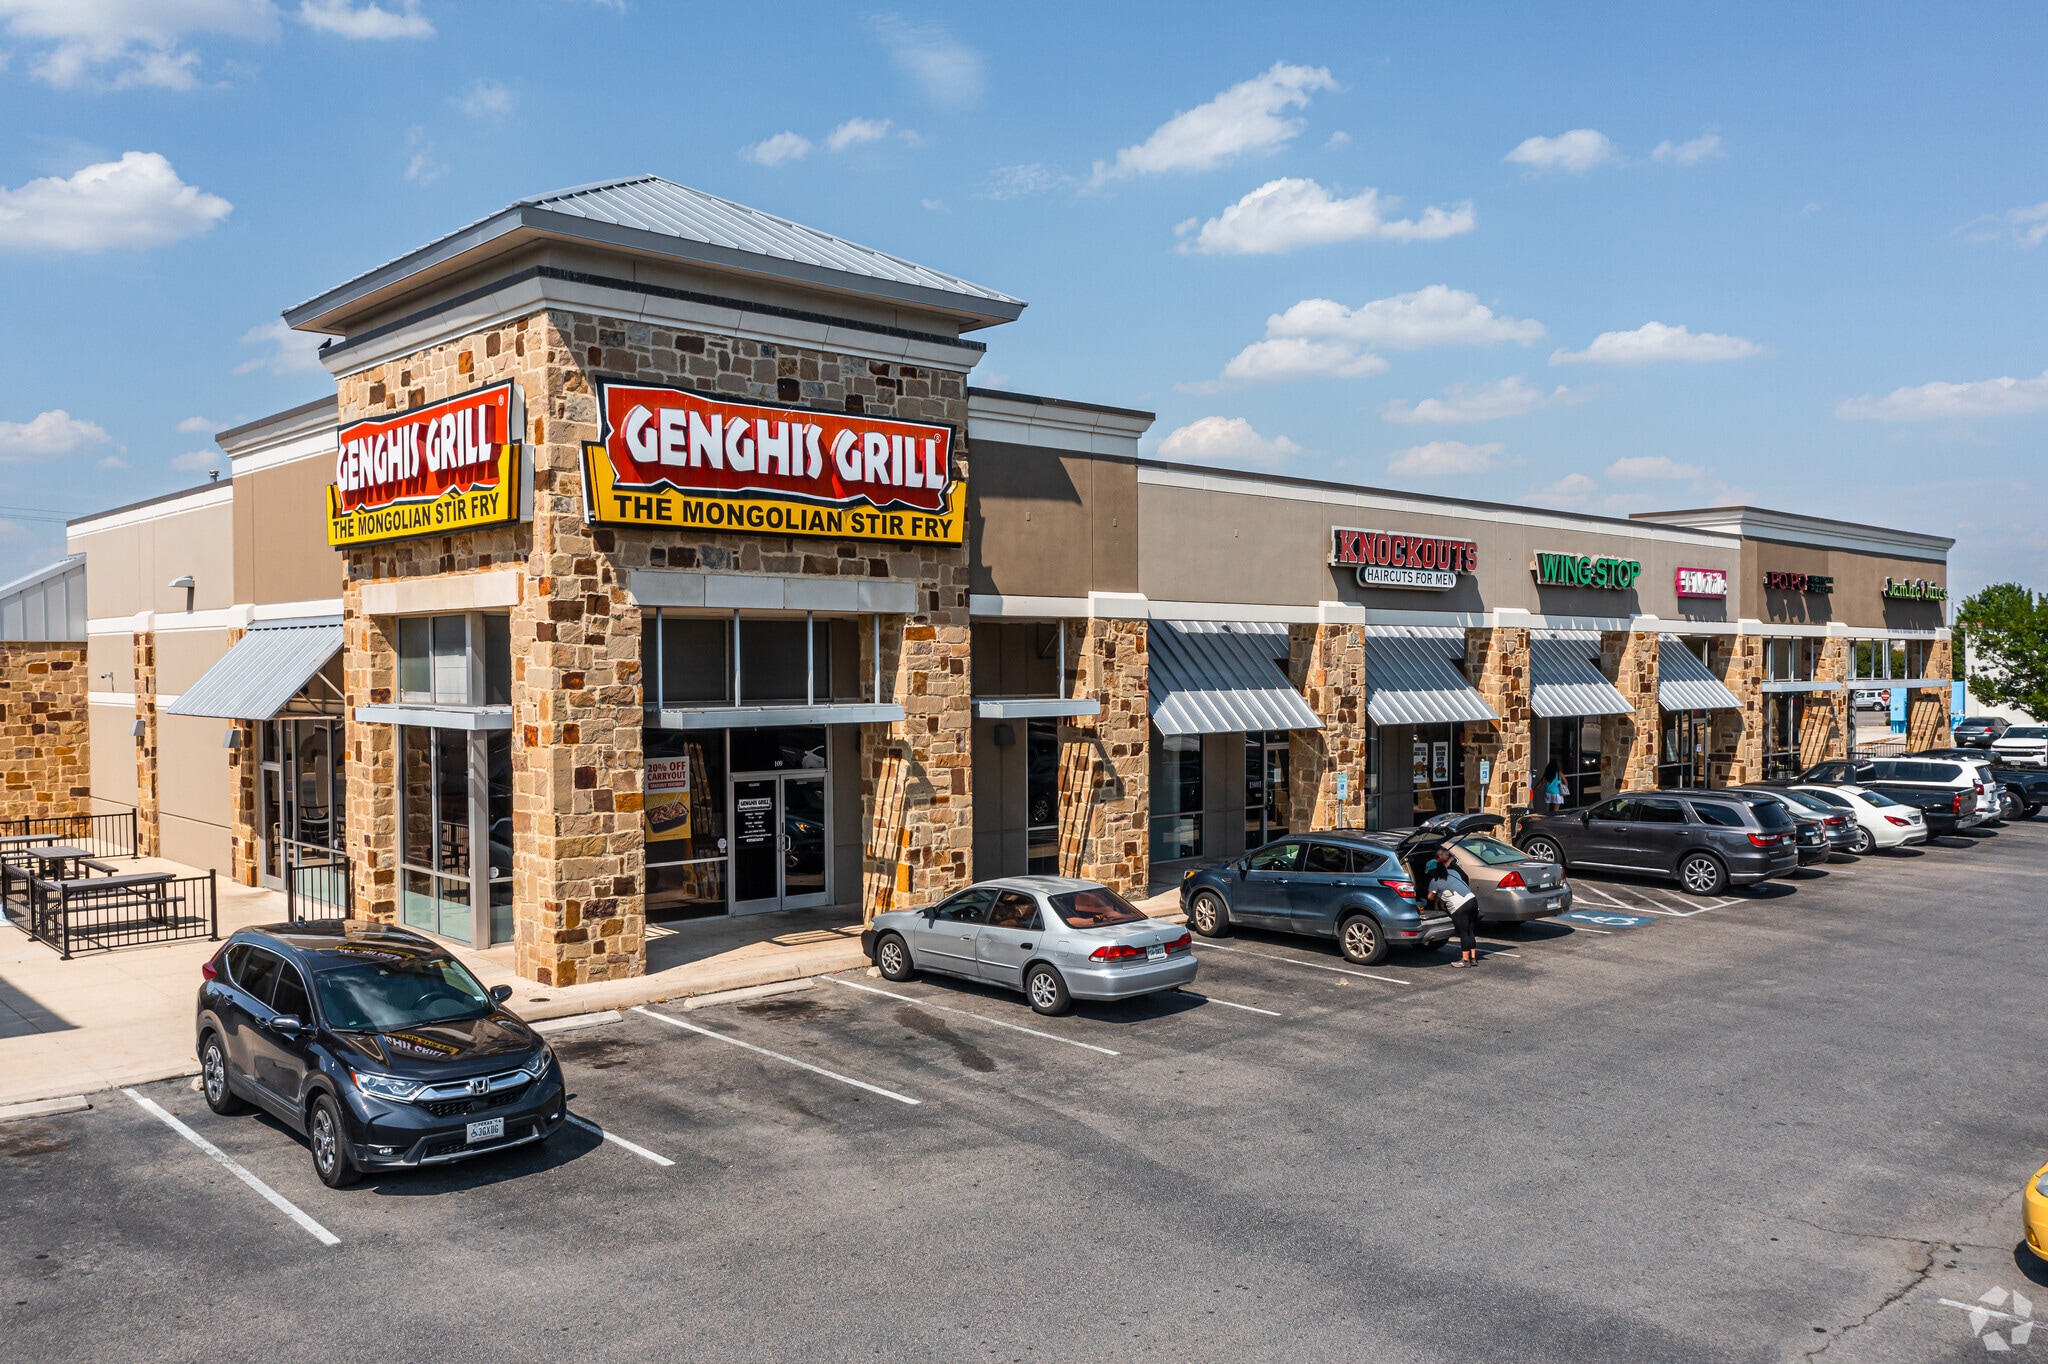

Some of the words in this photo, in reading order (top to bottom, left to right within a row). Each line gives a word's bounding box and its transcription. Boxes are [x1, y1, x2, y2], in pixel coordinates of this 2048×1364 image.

[336, 422, 420, 492] GENGHIS
[425, 404, 493, 472] GRILL
[621, 404, 823, 479] GENGHIS
[830, 428, 945, 489] GRILL
[333, 518, 354, 540] THE
[358, 505, 431, 536] MONGOLIAN
[435, 498, 467, 523] STIR
[471, 492, 499, 518] FRY
[613, 494, 672, 521] THE
[682, 500, 843, 532] MONGOLIAN
[851, 513, 905, 536] STIR
[911, 517, 953, 539] FRY
[1338, 530, 1478, 571] KNOCKOUTS
[1367, 568, 1413, 584] HAIRCUTS
[1416, 572, 1433, 585] FOR
[1435, 574, 1454, 586] MEN
[1888, 578, 1921, 598] Jamba
[1925, 581, 1950, 600] Juice
[647, 763, 667, 773] 20%
[669, 761, 686, 771] OFF
[647, 771, 686, 781] CARRYOUT
